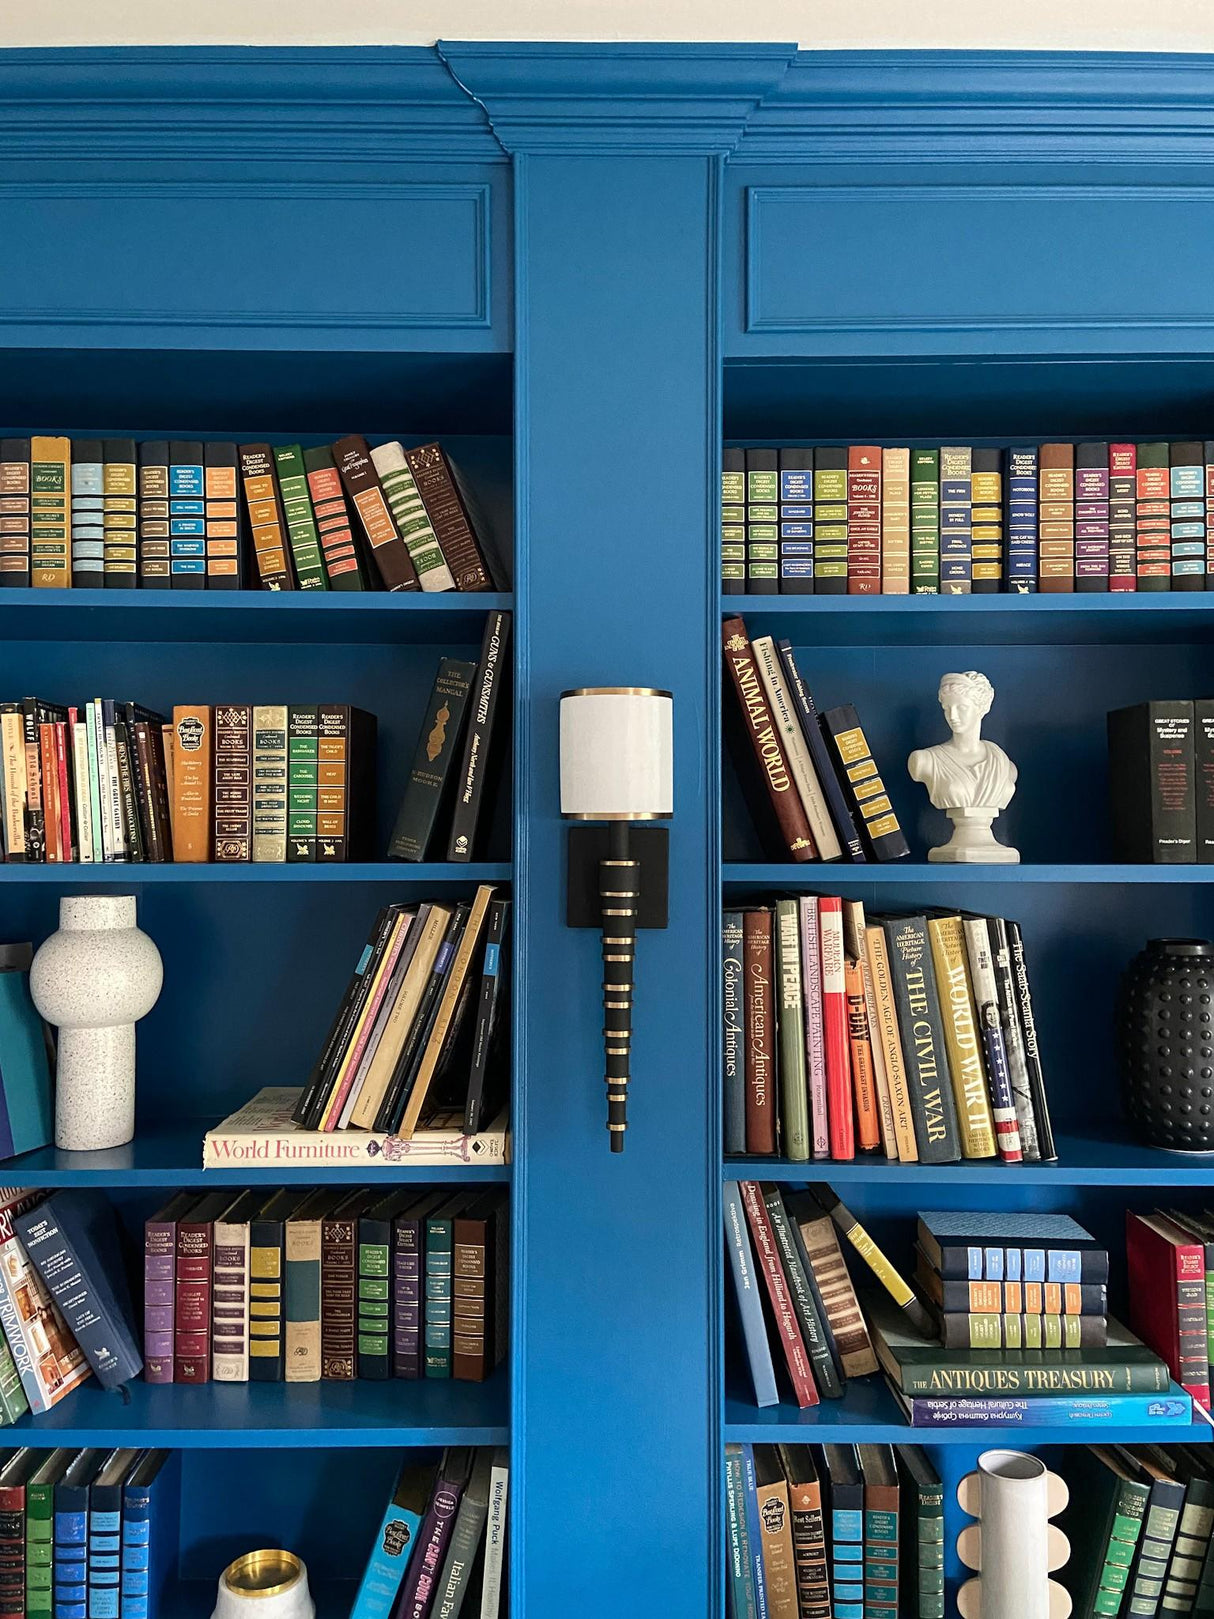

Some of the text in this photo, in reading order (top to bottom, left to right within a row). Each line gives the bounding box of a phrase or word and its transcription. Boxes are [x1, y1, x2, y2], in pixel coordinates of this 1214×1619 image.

[36, 474, 63, 484] BOOKS
[851, 484, 878, 493] BOOKS
[488, 636, 500, 662] GUNS
[437, 677, 470, 689] COLLECTOR'S
[448, 670, 461, 679] THE
[759, 643, 789, 723] Fishing in America
[787, 654, 810, 714] Freshwater Fishing Secrets
[436, 686, 464, 697] MANUAL
[477, 669, 493, 724] GUNSMITHS
[26, 714, 35, 741] WOLFF
[733, 658, 789, 791] ANIMAL WORLD
[9, 755, 17, 765] The
[10, 767, 18, 789] Hound
[28, 755, 38, 800] Old School
[11, 797, 19, 807] the
[125, 793, 133, 817] WILLIAM
[12, 809, 21, 846] Baskervilles
[895, 932, 924, 941] AMERICAN
[904, 925, 915, 934] The
[821, 929, 835, 976] WARFARE
[831, 931, 841, 972] MODERN
[897, 939, 925, 948] HERITAGE
[900, 945, 921, 954] Picture
[902, 952, 924, 962] History
[781, 913, 801, 1009] WAR IN PEACE
[910, 959, 917, 967] of
[807, 908, 824, 1076] BRITISH LANDSCAPE PAINTING
[861, 963, 879, 1029] MODEL AIRPLANES
[1005, 989, 1014, 1008] Attack
[1013, 940, 1039, 1059] The Saab-Scania Story
[725, 958, 742, 1076] Colonial Antiques
[847, 995, 871, 1041] D-DAY
[1009, 1014, 1017, 1029] Pearl
[751, 964, 769, 1106] American Antiques
[873, 939, 908, 1130] THE GOLDEN AGE OF ANGLO-SAXON ART
[948, 966, 990, 1130] WORLD WAR II
[1011, 1029, 1021, 1047] Harbor
[906, 967, 946, 1142] THE CIVIL WAR
[858, 1057, 867, 1085] GREATEST
[861, 1087, 870, 1112] INVASION
[882, 1095, 894, 1132] CRESCENT
[211, 1139, 360, 1159] World Furniture
[743, 1185, 760, 1217] Drawing
[27, 1220, 48, 1234] TODAY'S
[755, 1217, 764, 1225] in
[771, 1213, 781, 1224] An
[27, 1227, 59, 1248] NONFICTION
[33, 1227, 46, 1238] BEST
[730, 1203, 751, 1289] Jan Grimm Retrospektiva
[758, 1225, 772, 1254] England
[776, 1225, 793, 1259] Illustrated
[765, 1255, 776, 1273] from
[788, 1261, 805, 1294] Handbook
[771, 1274, 786, 1302] Hilliard
[800, 1303, 812, 1316] Art
[0, 1296, 33, 1376] TRIMWORK
[782, 1311, 797, 1340] Hogarth
[805, 1318, 819, 1343] History
[913, 1368, 1116, 1391] THE ANTIQUES TREASURY
[927, 1400, 1028, 1410] The Cultural Heritage of Serbia
[491, 1481, 503, 1545] Wolfgang Puck
[728, 1490, 736, 1522] SPERLING
[793, 1514, 822, 1523] Best Sellers
[415, 1521, 444, 1602] THE CAN'T COOK
[755, 1555, 763, 1585] TRANSFER
[445, 1561, 464, 1598] Italian
